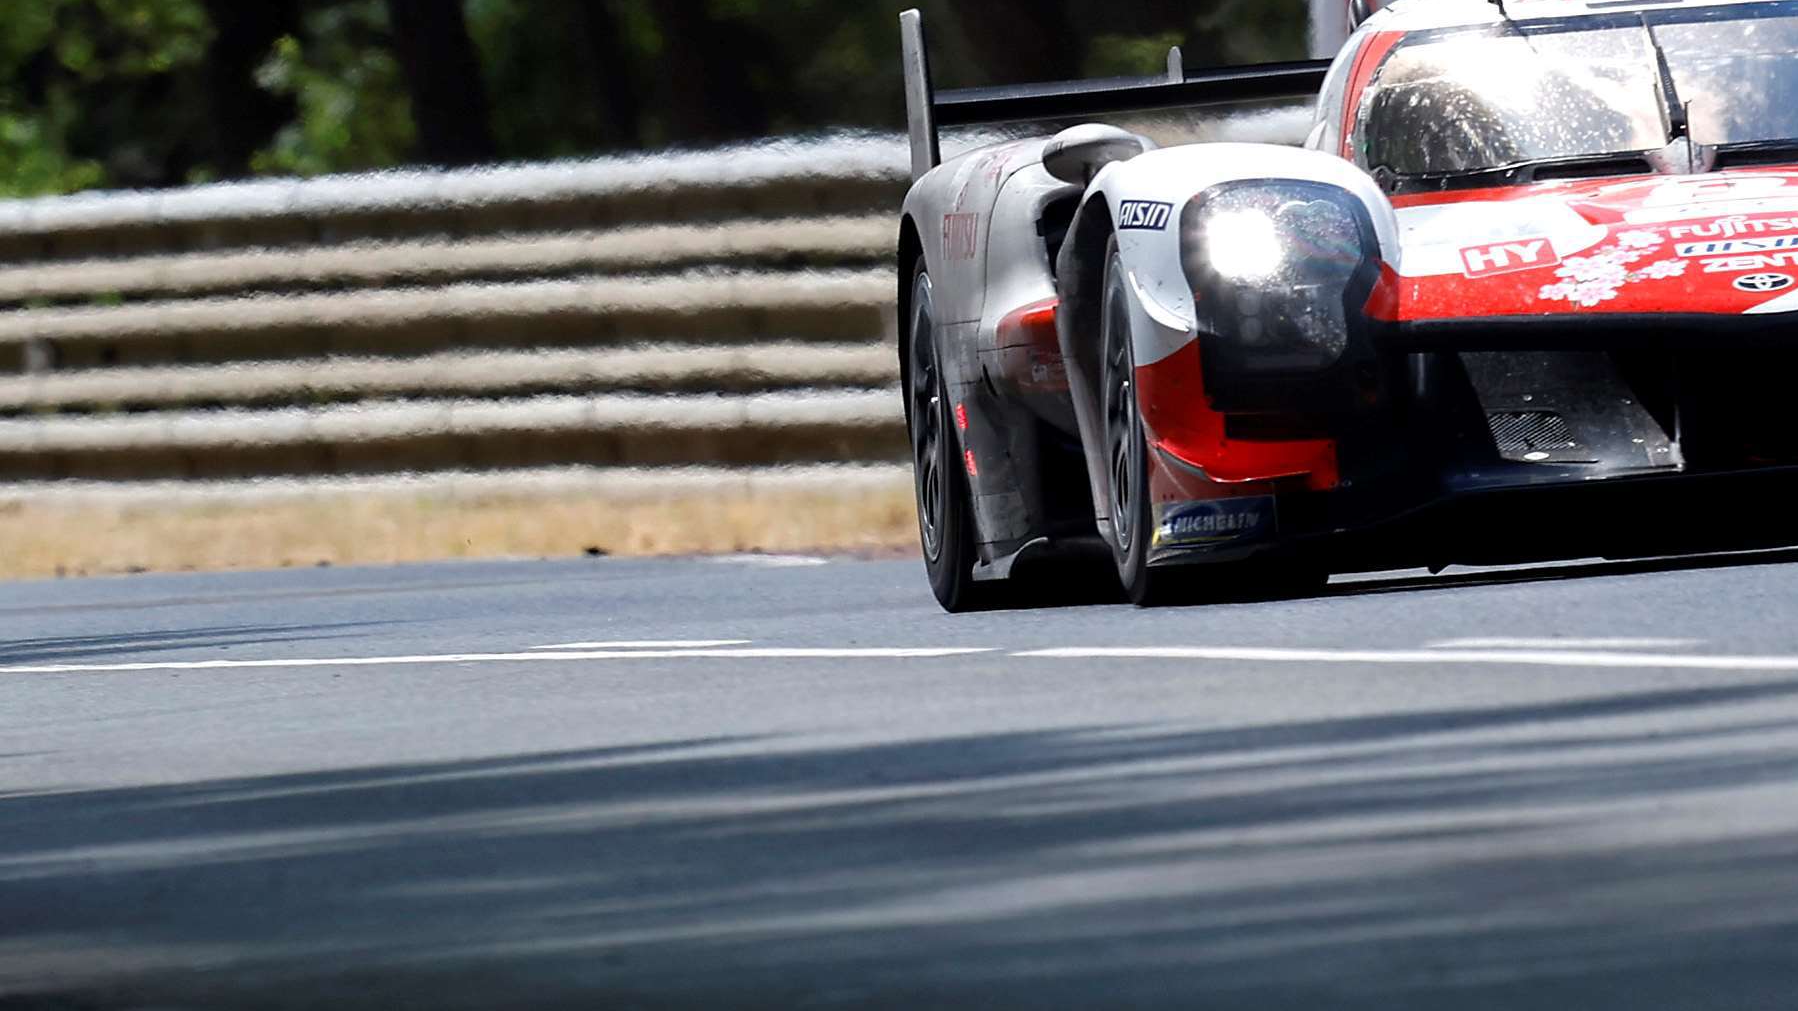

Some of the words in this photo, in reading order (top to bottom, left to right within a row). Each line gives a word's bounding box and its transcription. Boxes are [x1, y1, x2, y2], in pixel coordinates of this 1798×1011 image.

[1120, 202, 1171, 227] AISIN
[1464, 239, 1549, 272] HY
[1173, 512, 1260, 533] MICHELIN
